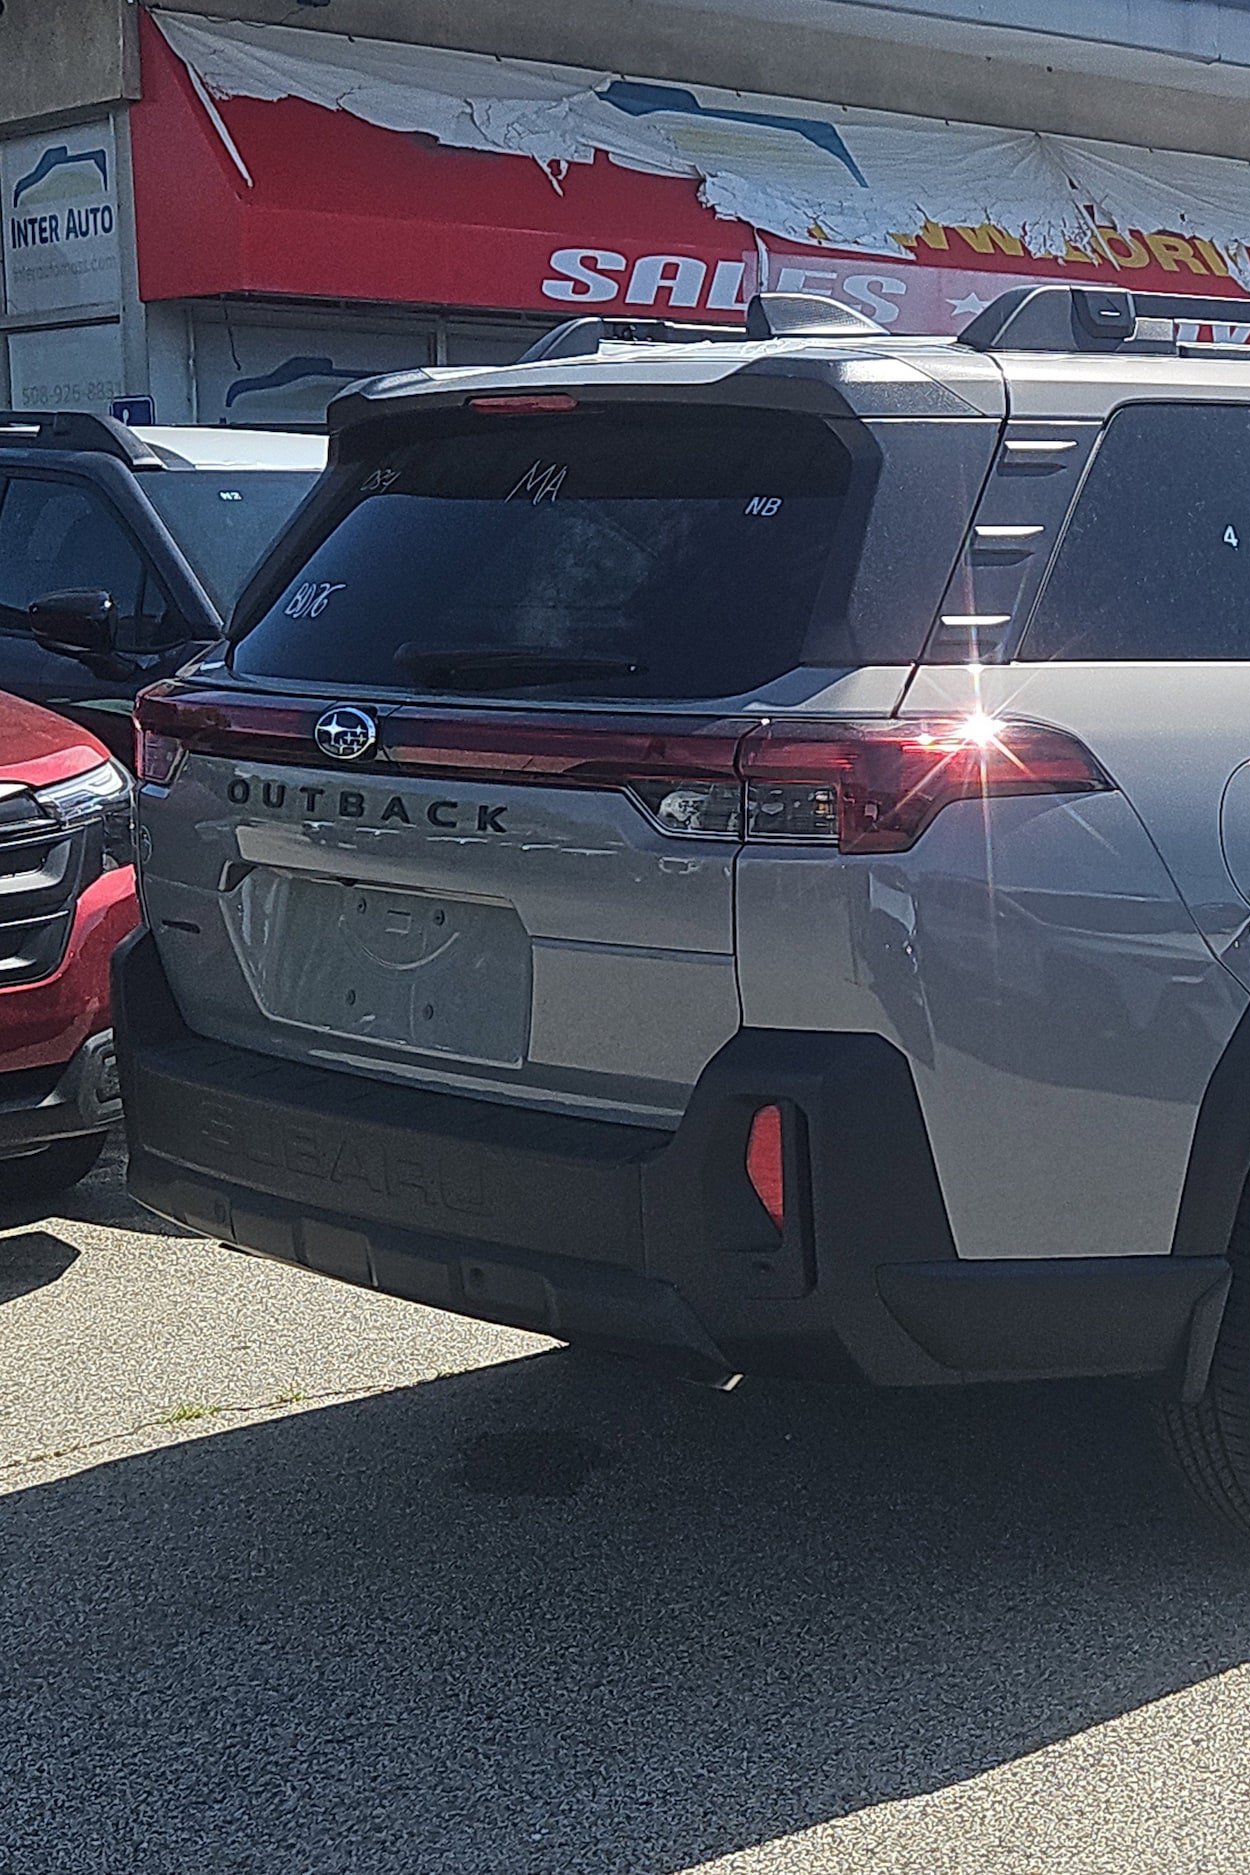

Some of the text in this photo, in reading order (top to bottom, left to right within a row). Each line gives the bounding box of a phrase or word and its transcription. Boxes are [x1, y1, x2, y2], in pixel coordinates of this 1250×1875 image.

[11, 205, 114, 250] INTER AUTO
[541, 247, 907, 324] SALES
[504, 457, 569, 506] MA
[744, 496, 782, 516] NB
[226, 779, 509, 834] OUTBACK
